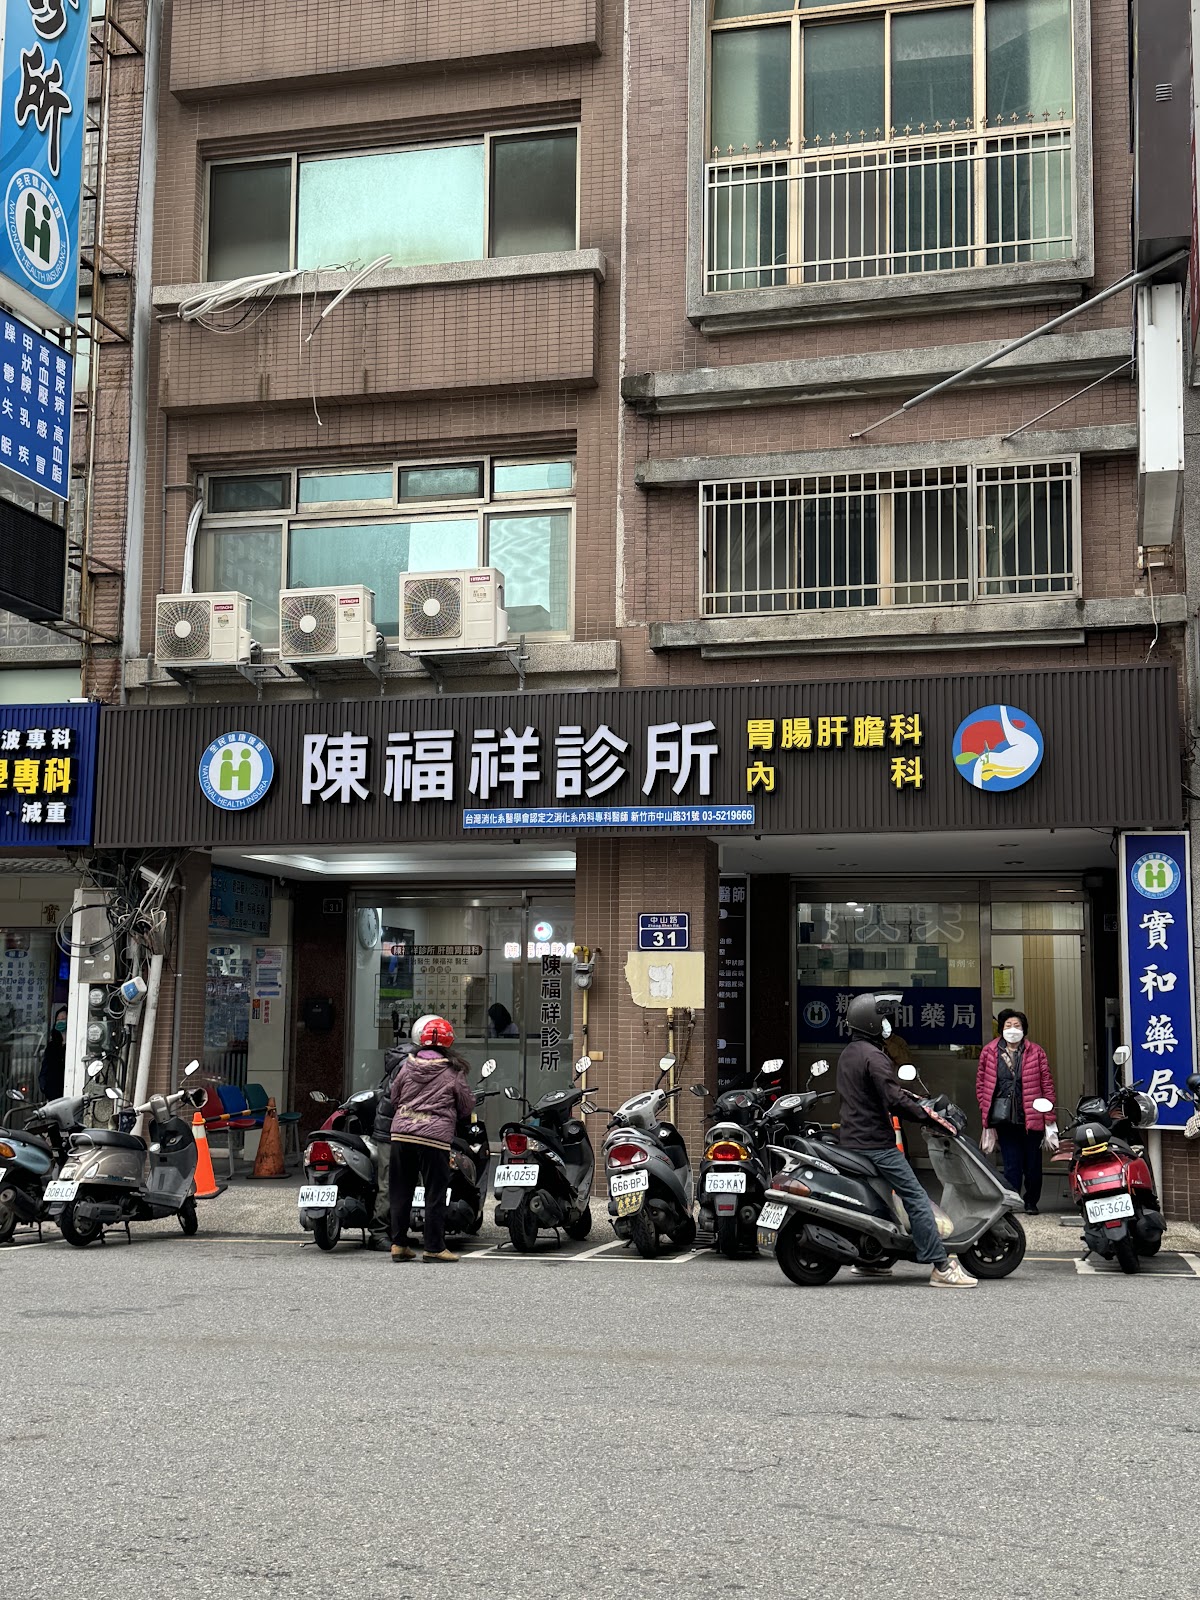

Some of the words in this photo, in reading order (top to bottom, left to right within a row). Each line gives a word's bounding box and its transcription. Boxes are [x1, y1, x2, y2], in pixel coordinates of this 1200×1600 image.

[8, 199, 22, 256] NATIONAL
[22, 255, 46, 283] HEALTH
[45, 239, 66, 283] INSURANCE
[1, 728, 71, 750] 波專科
[746, 713, 923, 751] 胃腸肝膽科
[302, 720, 719, 805] 陳福祥診所
[202, 765, 217, 800] NATIONAL
[217, 797, 246, 808] HEALTH
[631, 810, 700, 822] 新竹市中山路31號
[702, 809, 753, 821] 03-5219666
[650, 916, 678, 924] 中山路
[652, 931, 676, 947] 31
[540, 954, 562, 1073] 陳福祥診所
[1139, 910, 1179, 1110] 實和藥局
[814, 1160, 836, 1173] KYMCO
